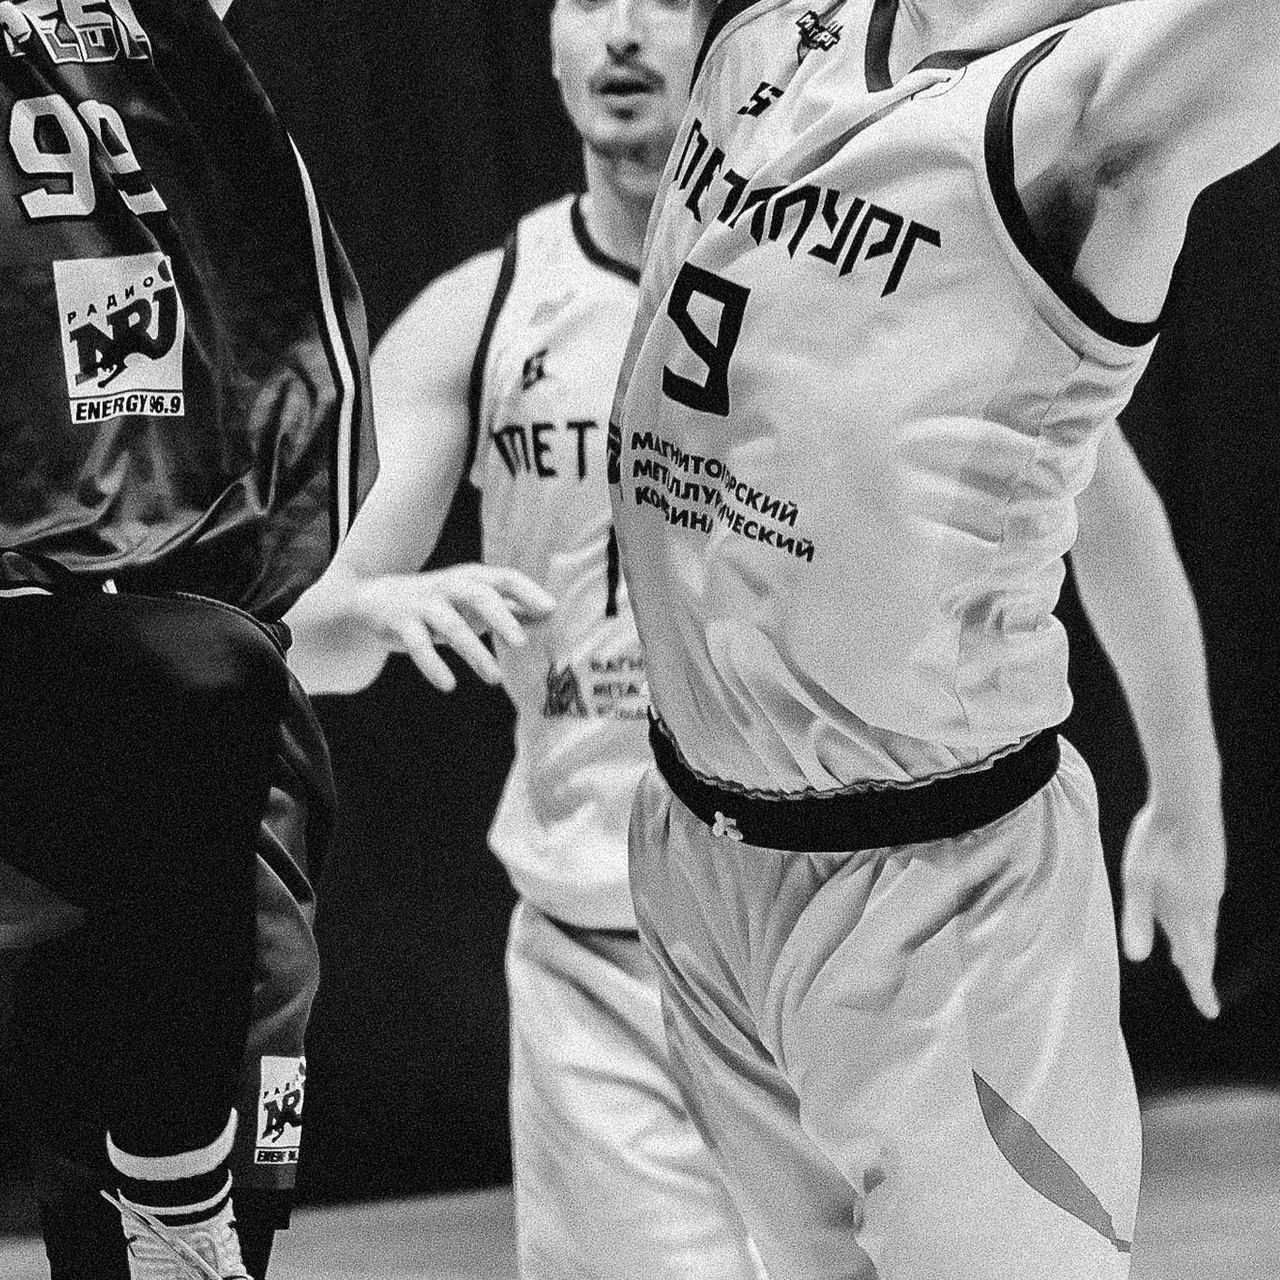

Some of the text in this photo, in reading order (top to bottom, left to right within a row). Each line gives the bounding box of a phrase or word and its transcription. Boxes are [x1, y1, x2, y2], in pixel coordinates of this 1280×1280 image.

[9, 93, 168, 218] 99
[67, 276, 155, 325] РАДИО
[69, 285, 178, 389] NRJ
[661, 260, 752, 418] 9
[76, 394, 148, 421] ENERGY
